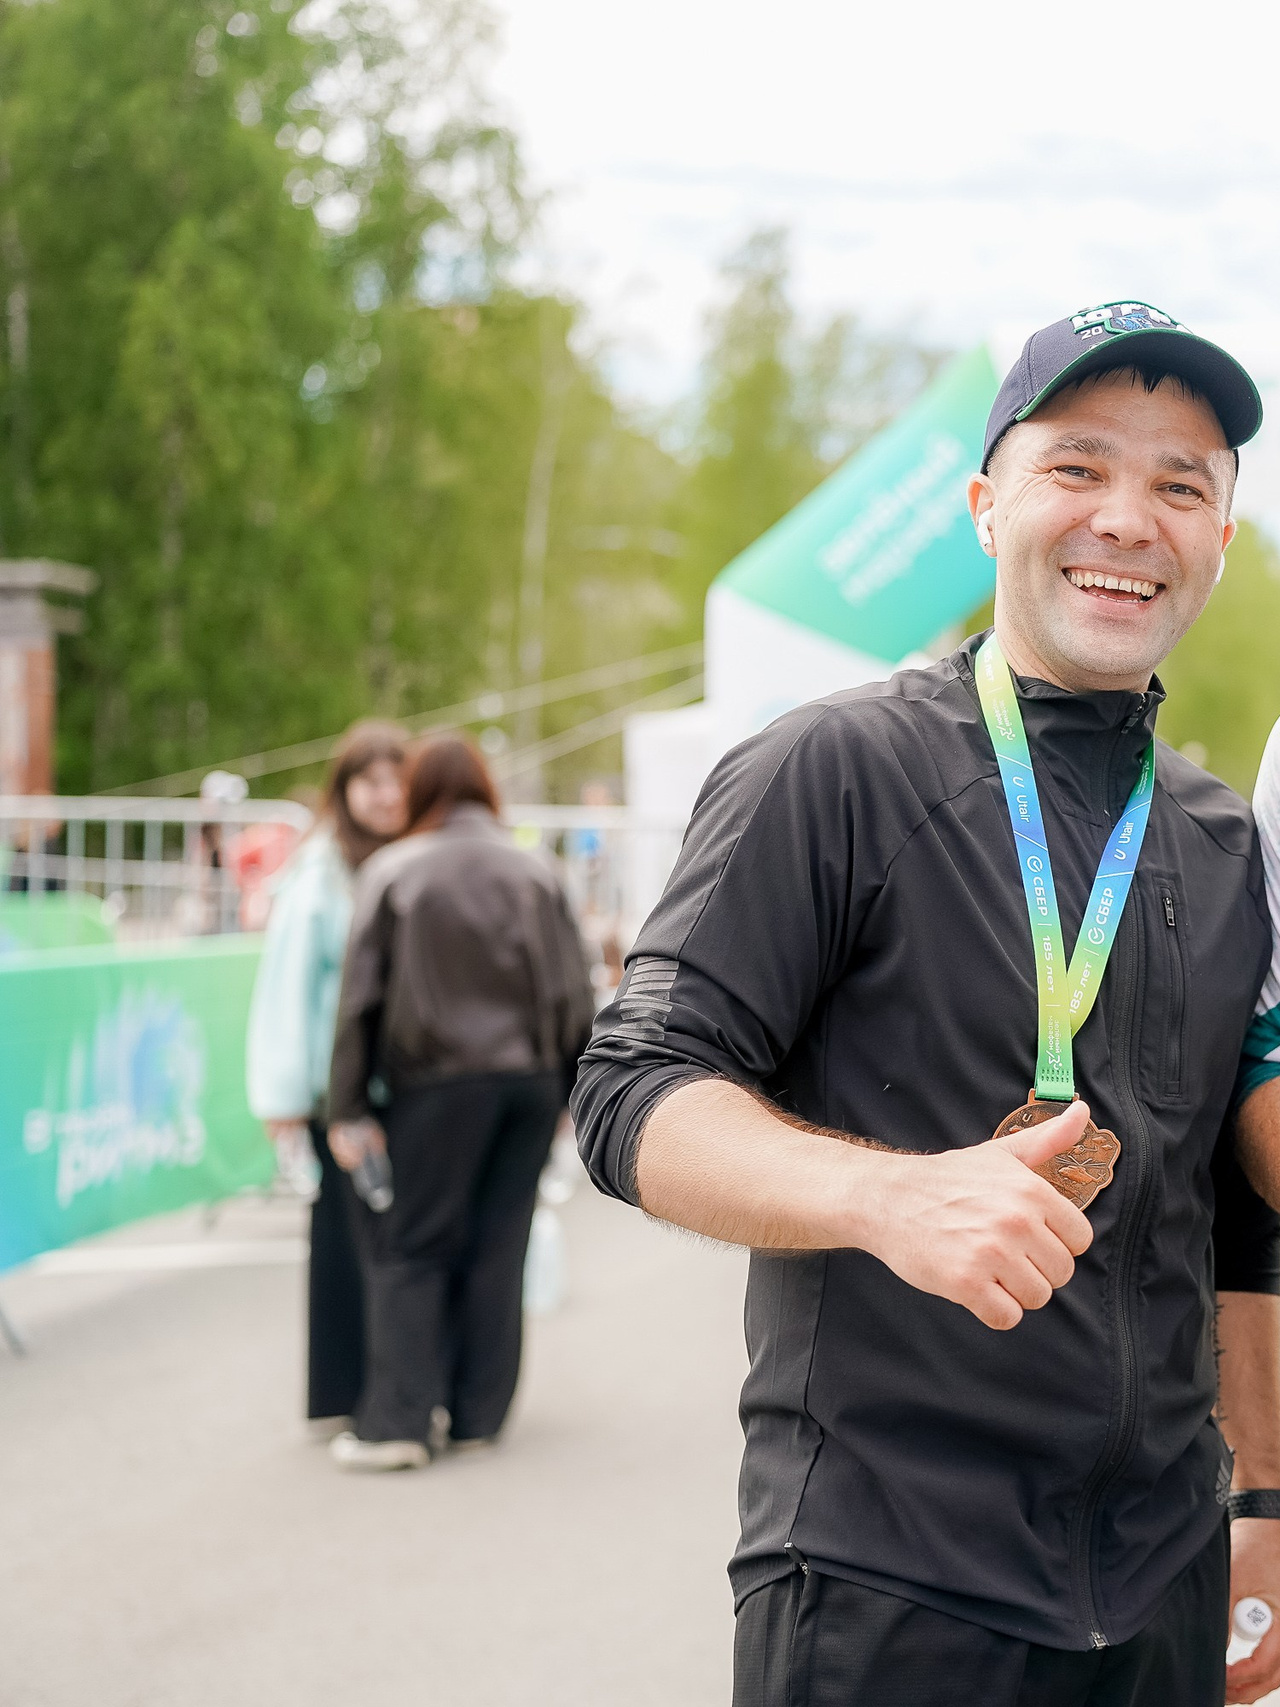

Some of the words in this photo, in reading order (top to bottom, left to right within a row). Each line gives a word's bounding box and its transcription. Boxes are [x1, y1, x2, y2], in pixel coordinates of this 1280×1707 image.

[1016, 794, 1031, 823] Utair
[1118, 821, 1135, 844] Utair
[1032, 876, 1048, 916] СБЕР
[1096, 887, 1115, 925] СБЕР
[1042, 936, 1054, 961] 185
[1046, 965, 1055, 994] лет
[1069, 989, 1084, 1014] 185
[1080, 961, 1093, 988] лет
